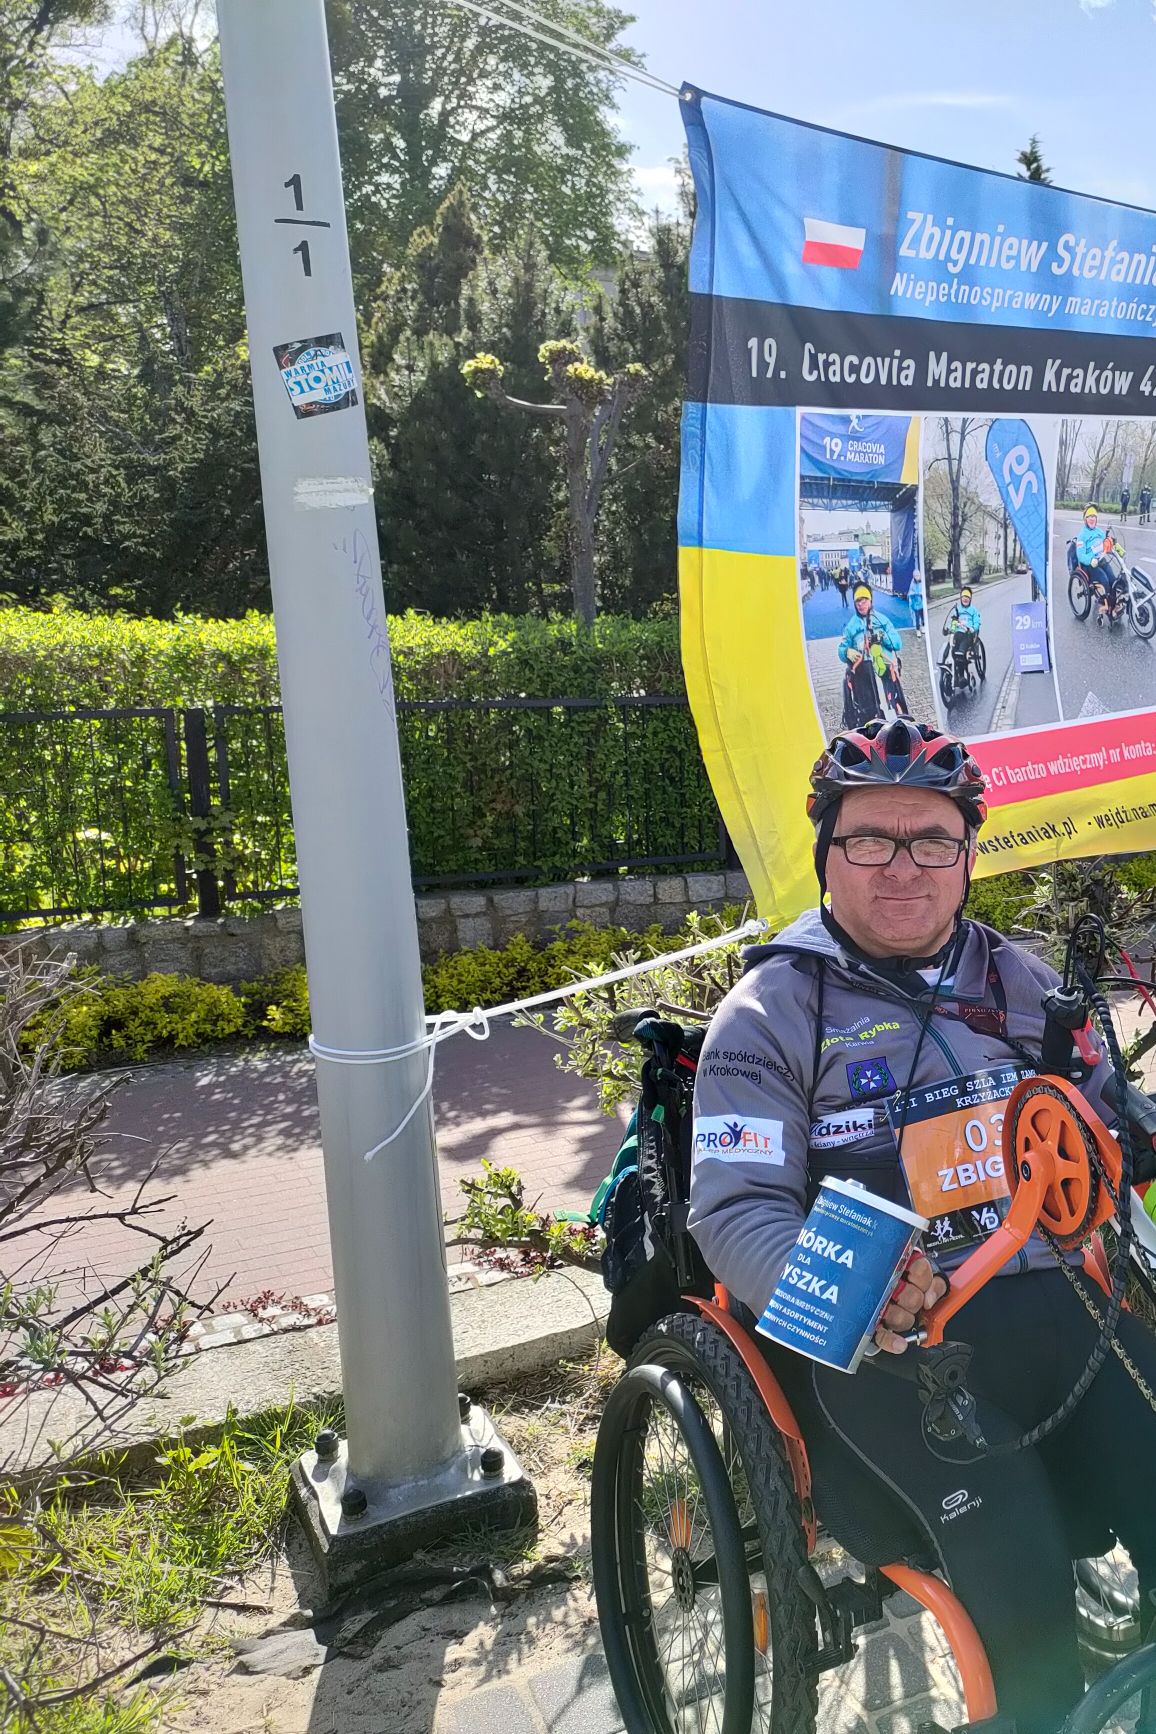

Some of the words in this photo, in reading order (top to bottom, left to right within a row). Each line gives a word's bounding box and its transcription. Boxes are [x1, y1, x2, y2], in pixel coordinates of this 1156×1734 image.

[284, 173, 304, 211] 1
[899, 211, 1048, 273] Zbigniew
[293, 240, 312, 277] 1
[890, 272, 1062, 316] Niepełnosprawny
[284, 360, 327, 378] WARMIA
[288, 361, 353, 396] STOMIL
[748, 337, 786, 379] 19.
[802, 343, 915, 386] Cracovia
[927, 351, 1033, 391] Maraton
[1042, 359, 1133, 395] Kraków
[823, 437, 844, 461] 19.
[848, 441, 885, 454] CRACOVIA
[846, 452, 885, 465] MARATON
[1015, 615, 1031, 630] 29
[991, 766, 1007, 787] Ci
[1006, 761, 1046, 785] bardzo
[1047, 746, 1108, 775] wdzięczny!
[1108, 747, 1121, 764] nr
[1121, 741, 1156, 761] konta:
[1094, 805, 1130, 830] wejdź
[1131, 805, 1147, 821] na
[821, 1036, 854, 1054] Złota
[858, 1021, 900, 1040] Rybka
[825, 1016, 870, 1034] Smażalnia
[709, 1064, 762, 1085] Krokowej
[722, 1050, 795, 1082] spółdzielczy
[925, 1085, 959, 1103] BIEG
[966, 1071, 1018, 1092] SZLAIEM
[838, 1204, 873, 1227] Stefaniak
[797, 1253, 811, 1265] DLA
[782, 1306, 828, 1334] ASORTYMENT
[787, 1324, 827, 1347] CZYNNOŚCI
[940, 1496, 983, 1524] Kalenji
